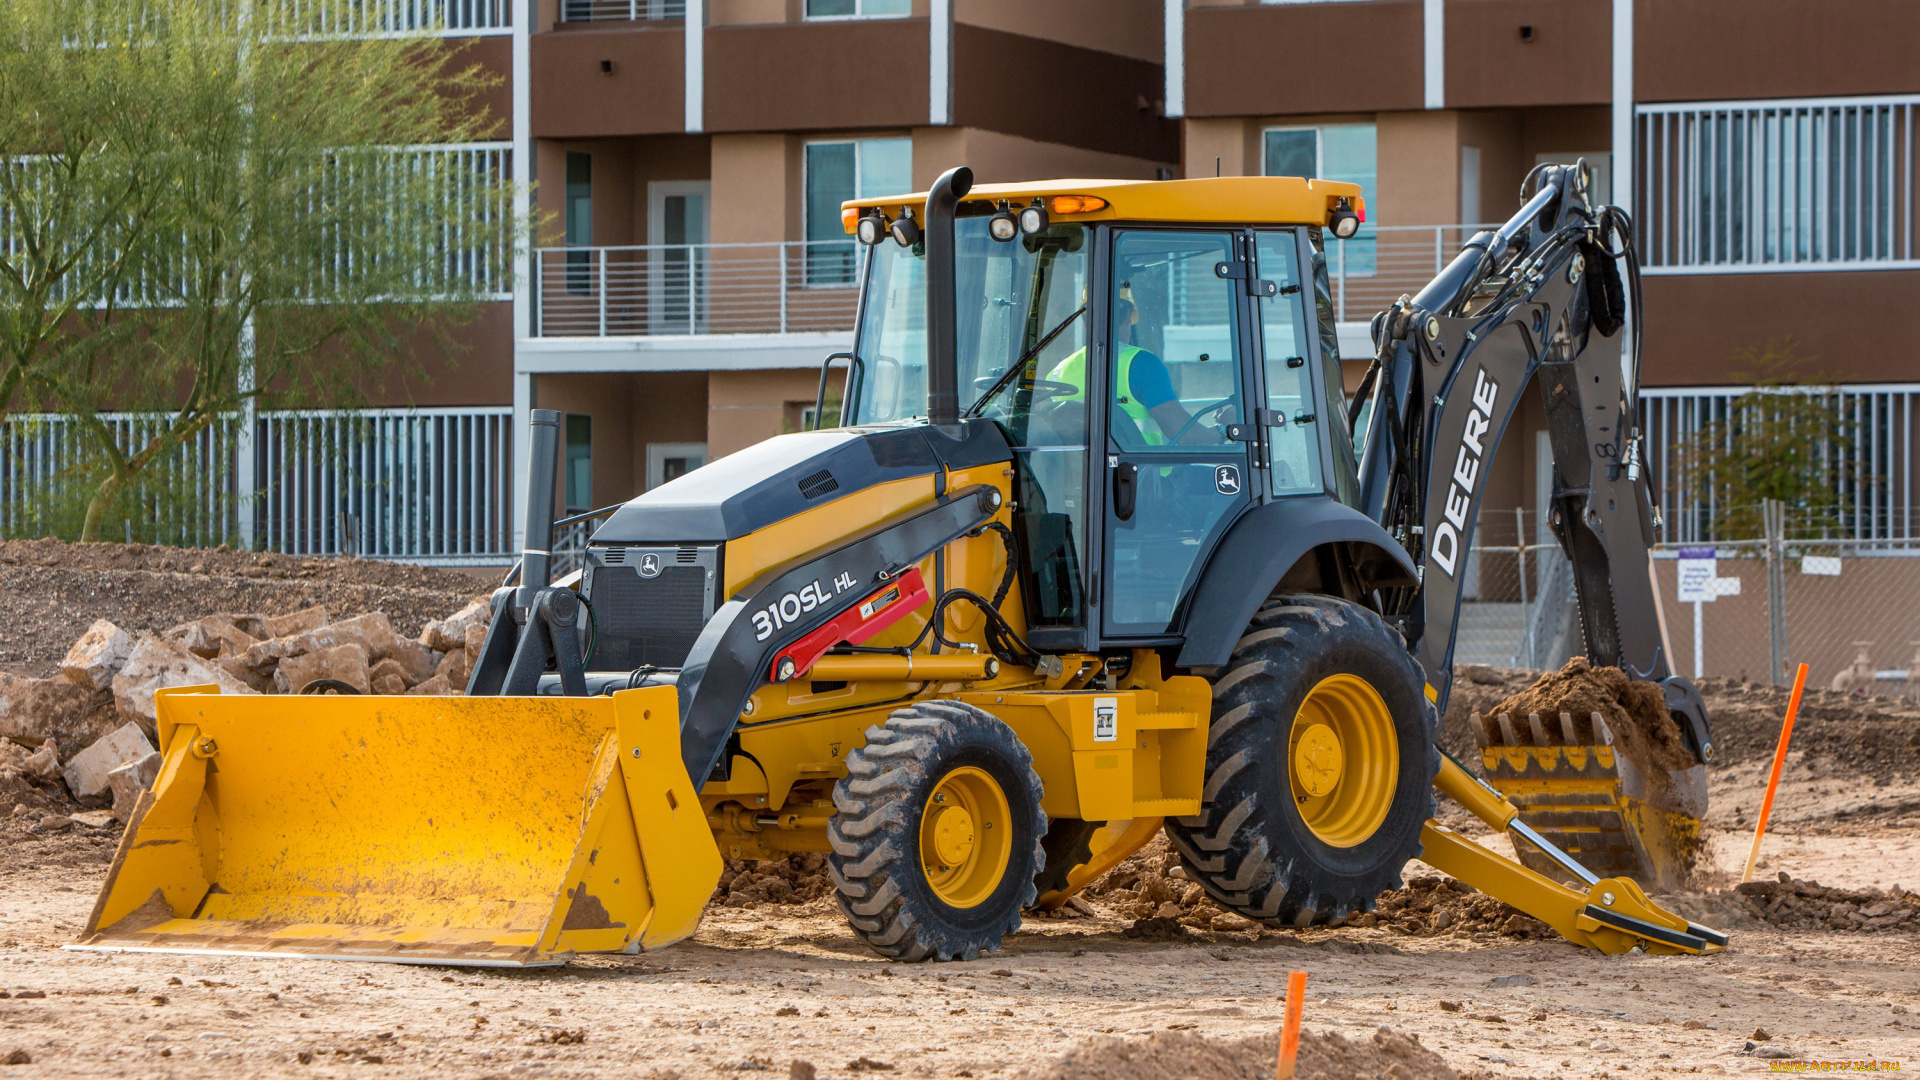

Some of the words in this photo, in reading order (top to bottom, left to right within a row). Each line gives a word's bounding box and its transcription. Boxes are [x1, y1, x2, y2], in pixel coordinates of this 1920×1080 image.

[1431, 368, 1498, 577] DEERE
[751, 580, 833, 641] 310SL
[834, 571, 858, 595] HL
